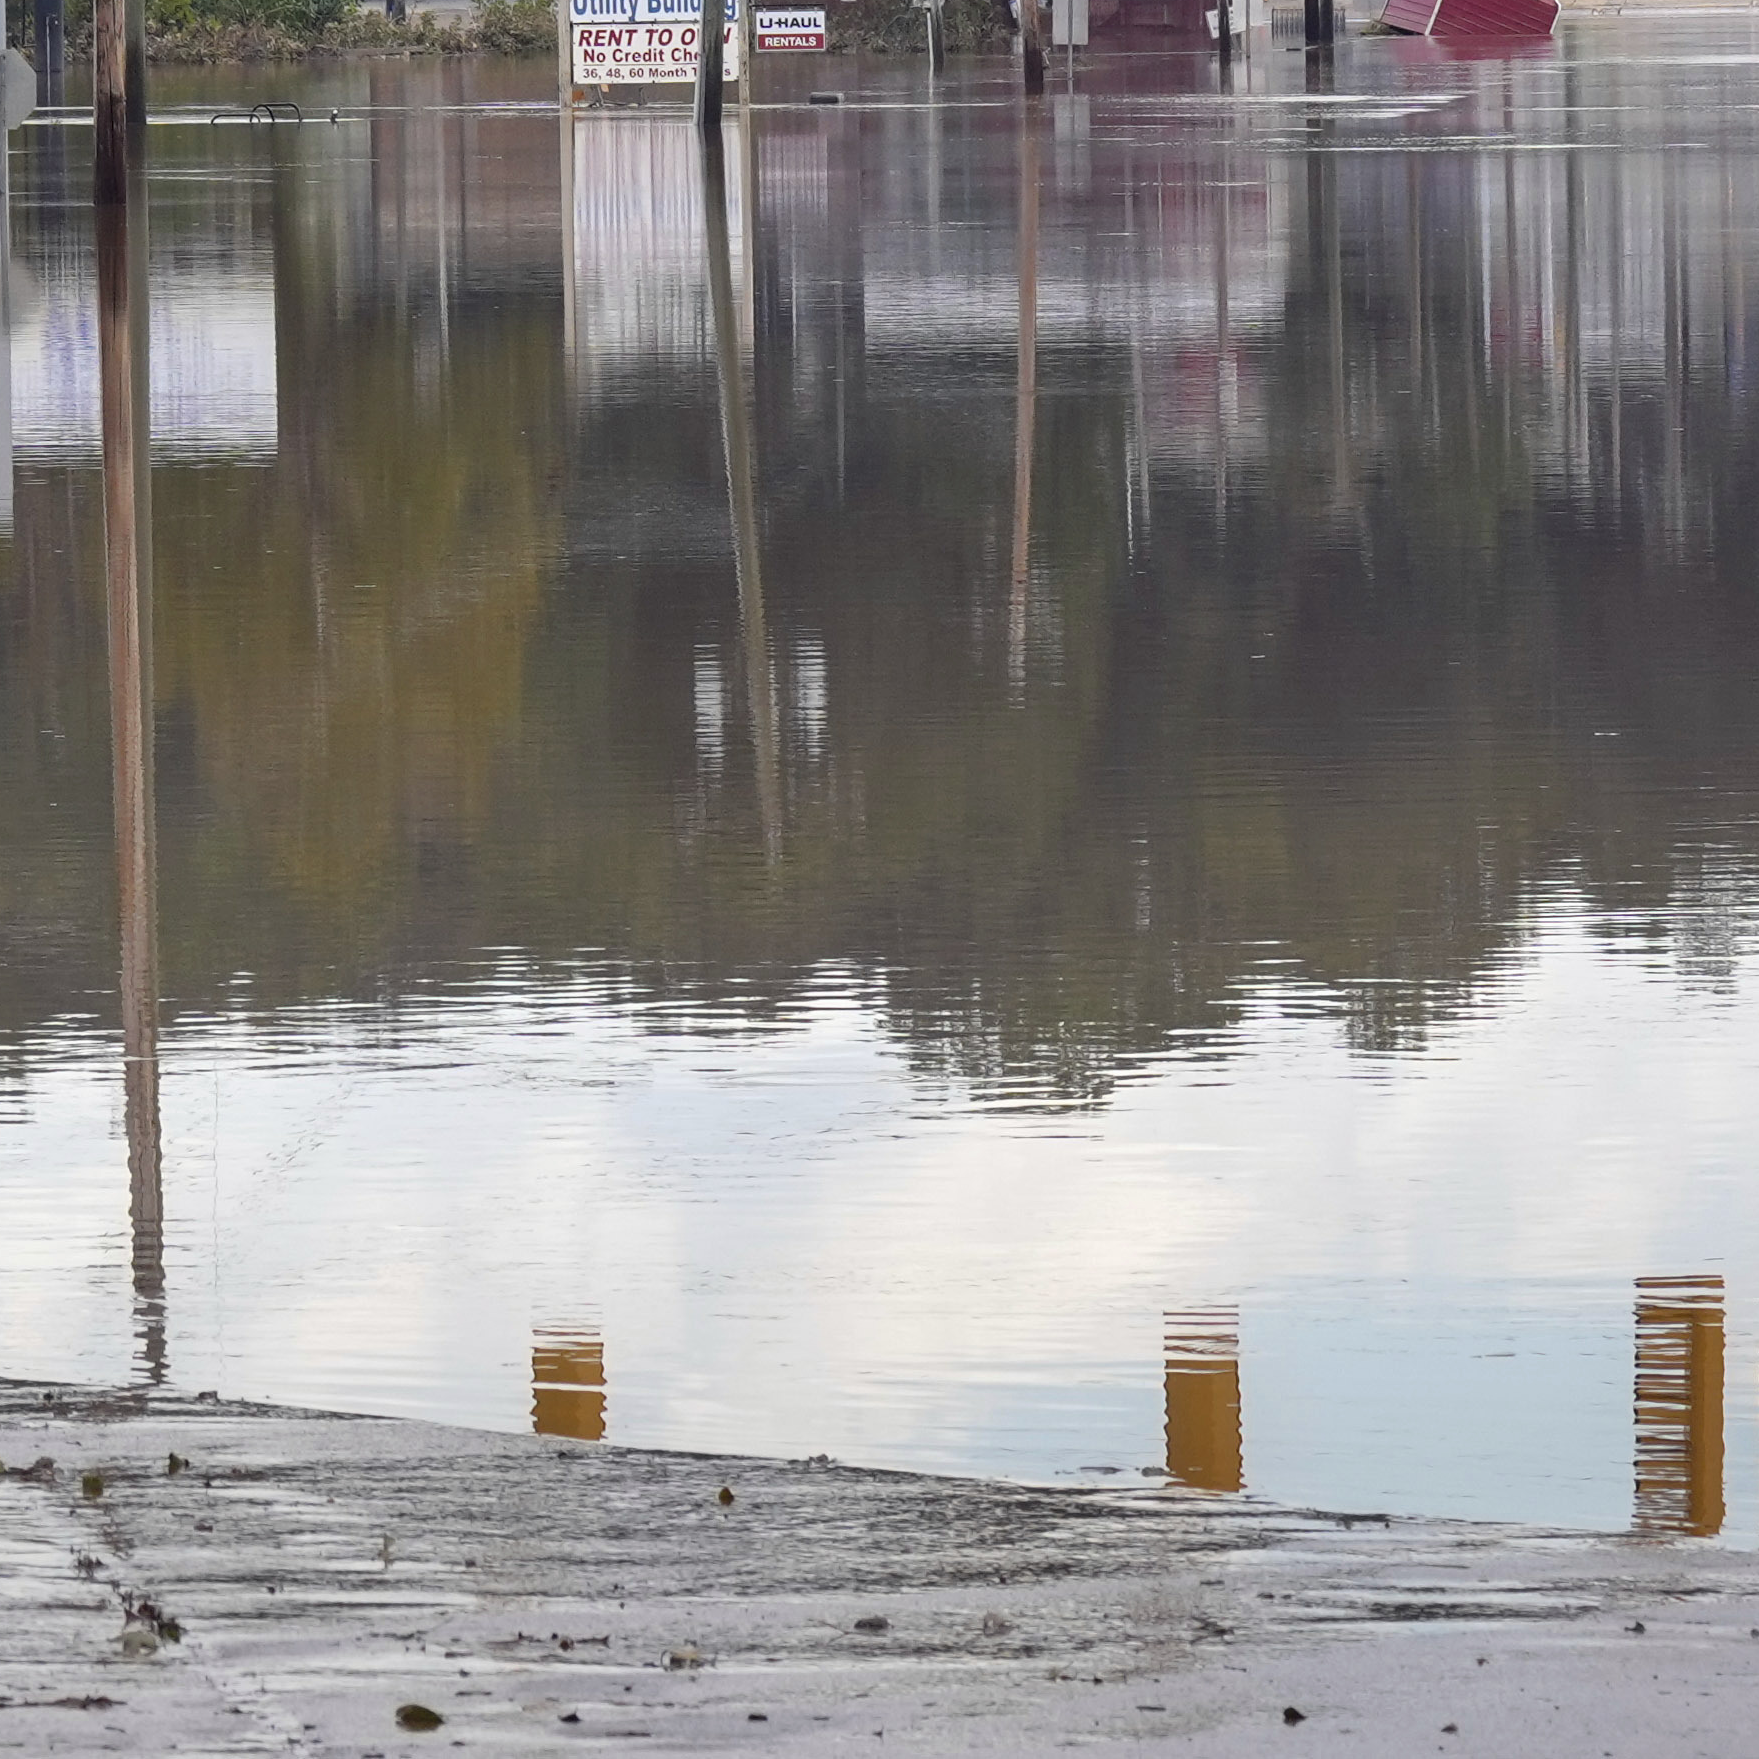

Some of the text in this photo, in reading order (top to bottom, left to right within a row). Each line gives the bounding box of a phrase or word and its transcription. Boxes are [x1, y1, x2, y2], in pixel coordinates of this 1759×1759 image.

[760, 17, 821, 29] U-HAUL
[578, 28, 732, 47] RENT TO ON
[765, 37, 817, 47] RENTALS
[583, 48, 701, 63] No Credit Che
[583, 69, 601, 79] 36,
[606, 68, 625, 79] 48,
[629, 68, 644, 77] 60
[648, 66, 688, 78] Month
